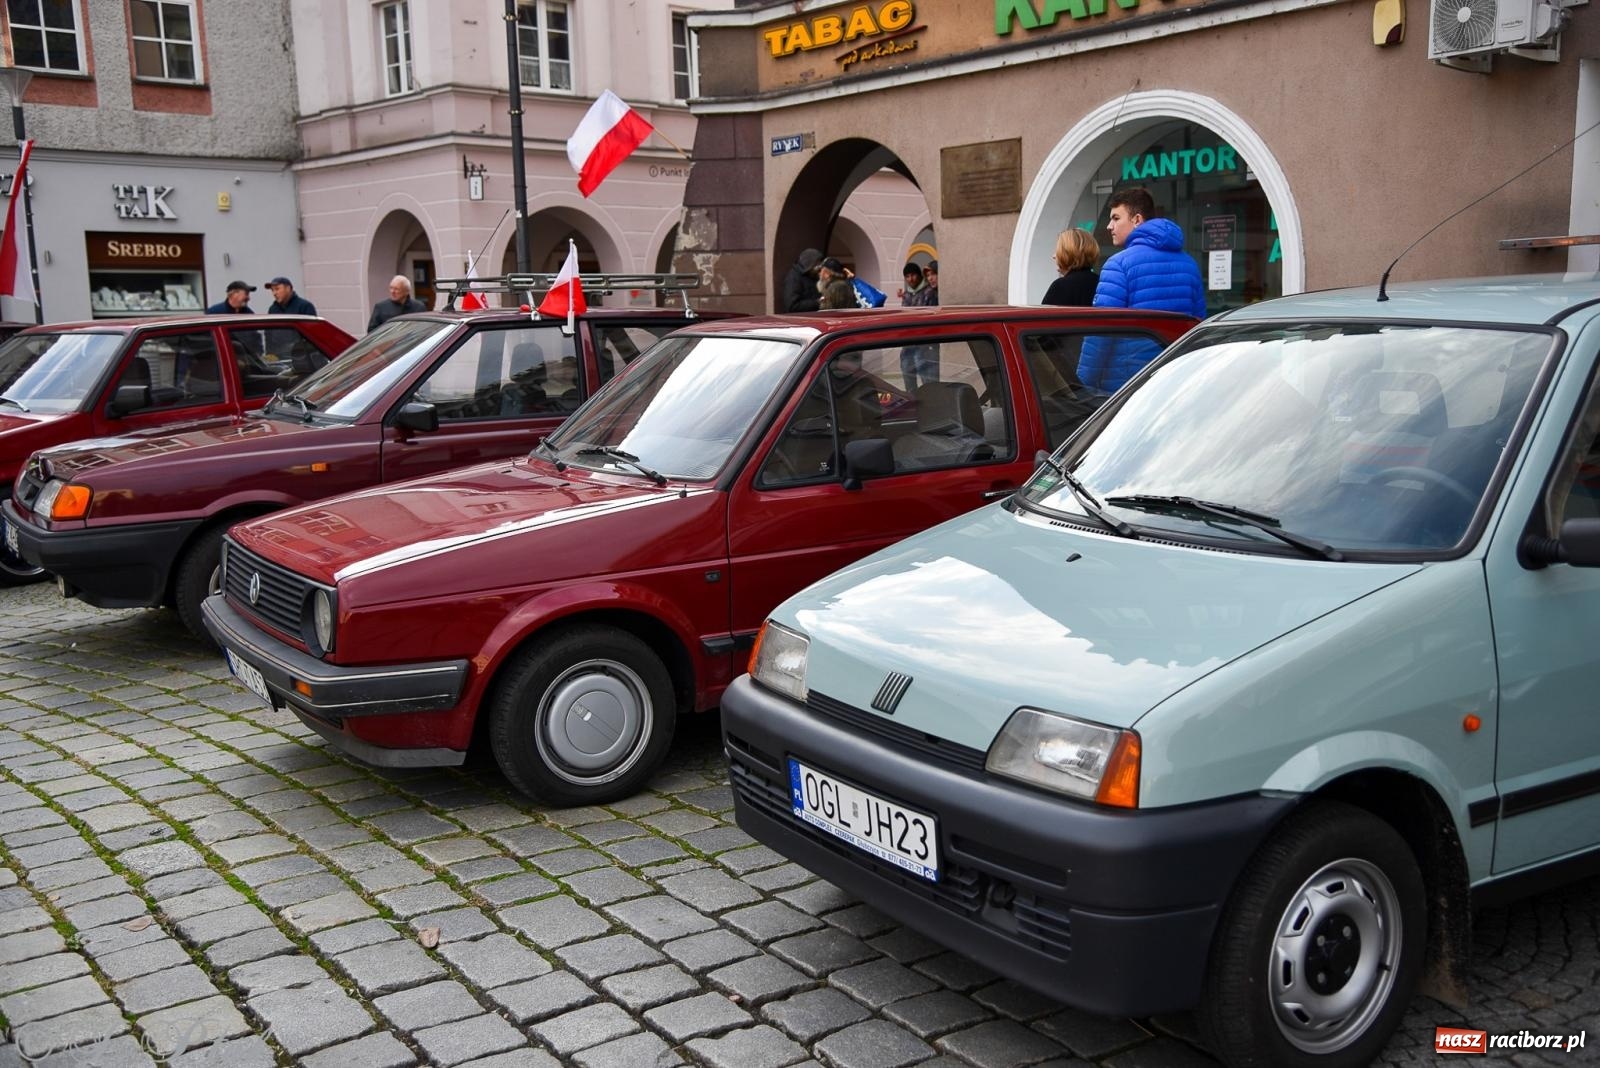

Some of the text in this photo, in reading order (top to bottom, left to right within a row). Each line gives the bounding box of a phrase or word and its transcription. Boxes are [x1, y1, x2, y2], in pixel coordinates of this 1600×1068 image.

[765, 0, 912, 57] TABAC
[841, 50, 858, 72] pod
[660, 167, 682, 177] Punkt
[1122, 144, 1236, 181] KANTOR
[107, 240, 182, 258] SREBRO
[794, 787, 802, 801] PL
[805, 772, 928, 861] OGL JH23
